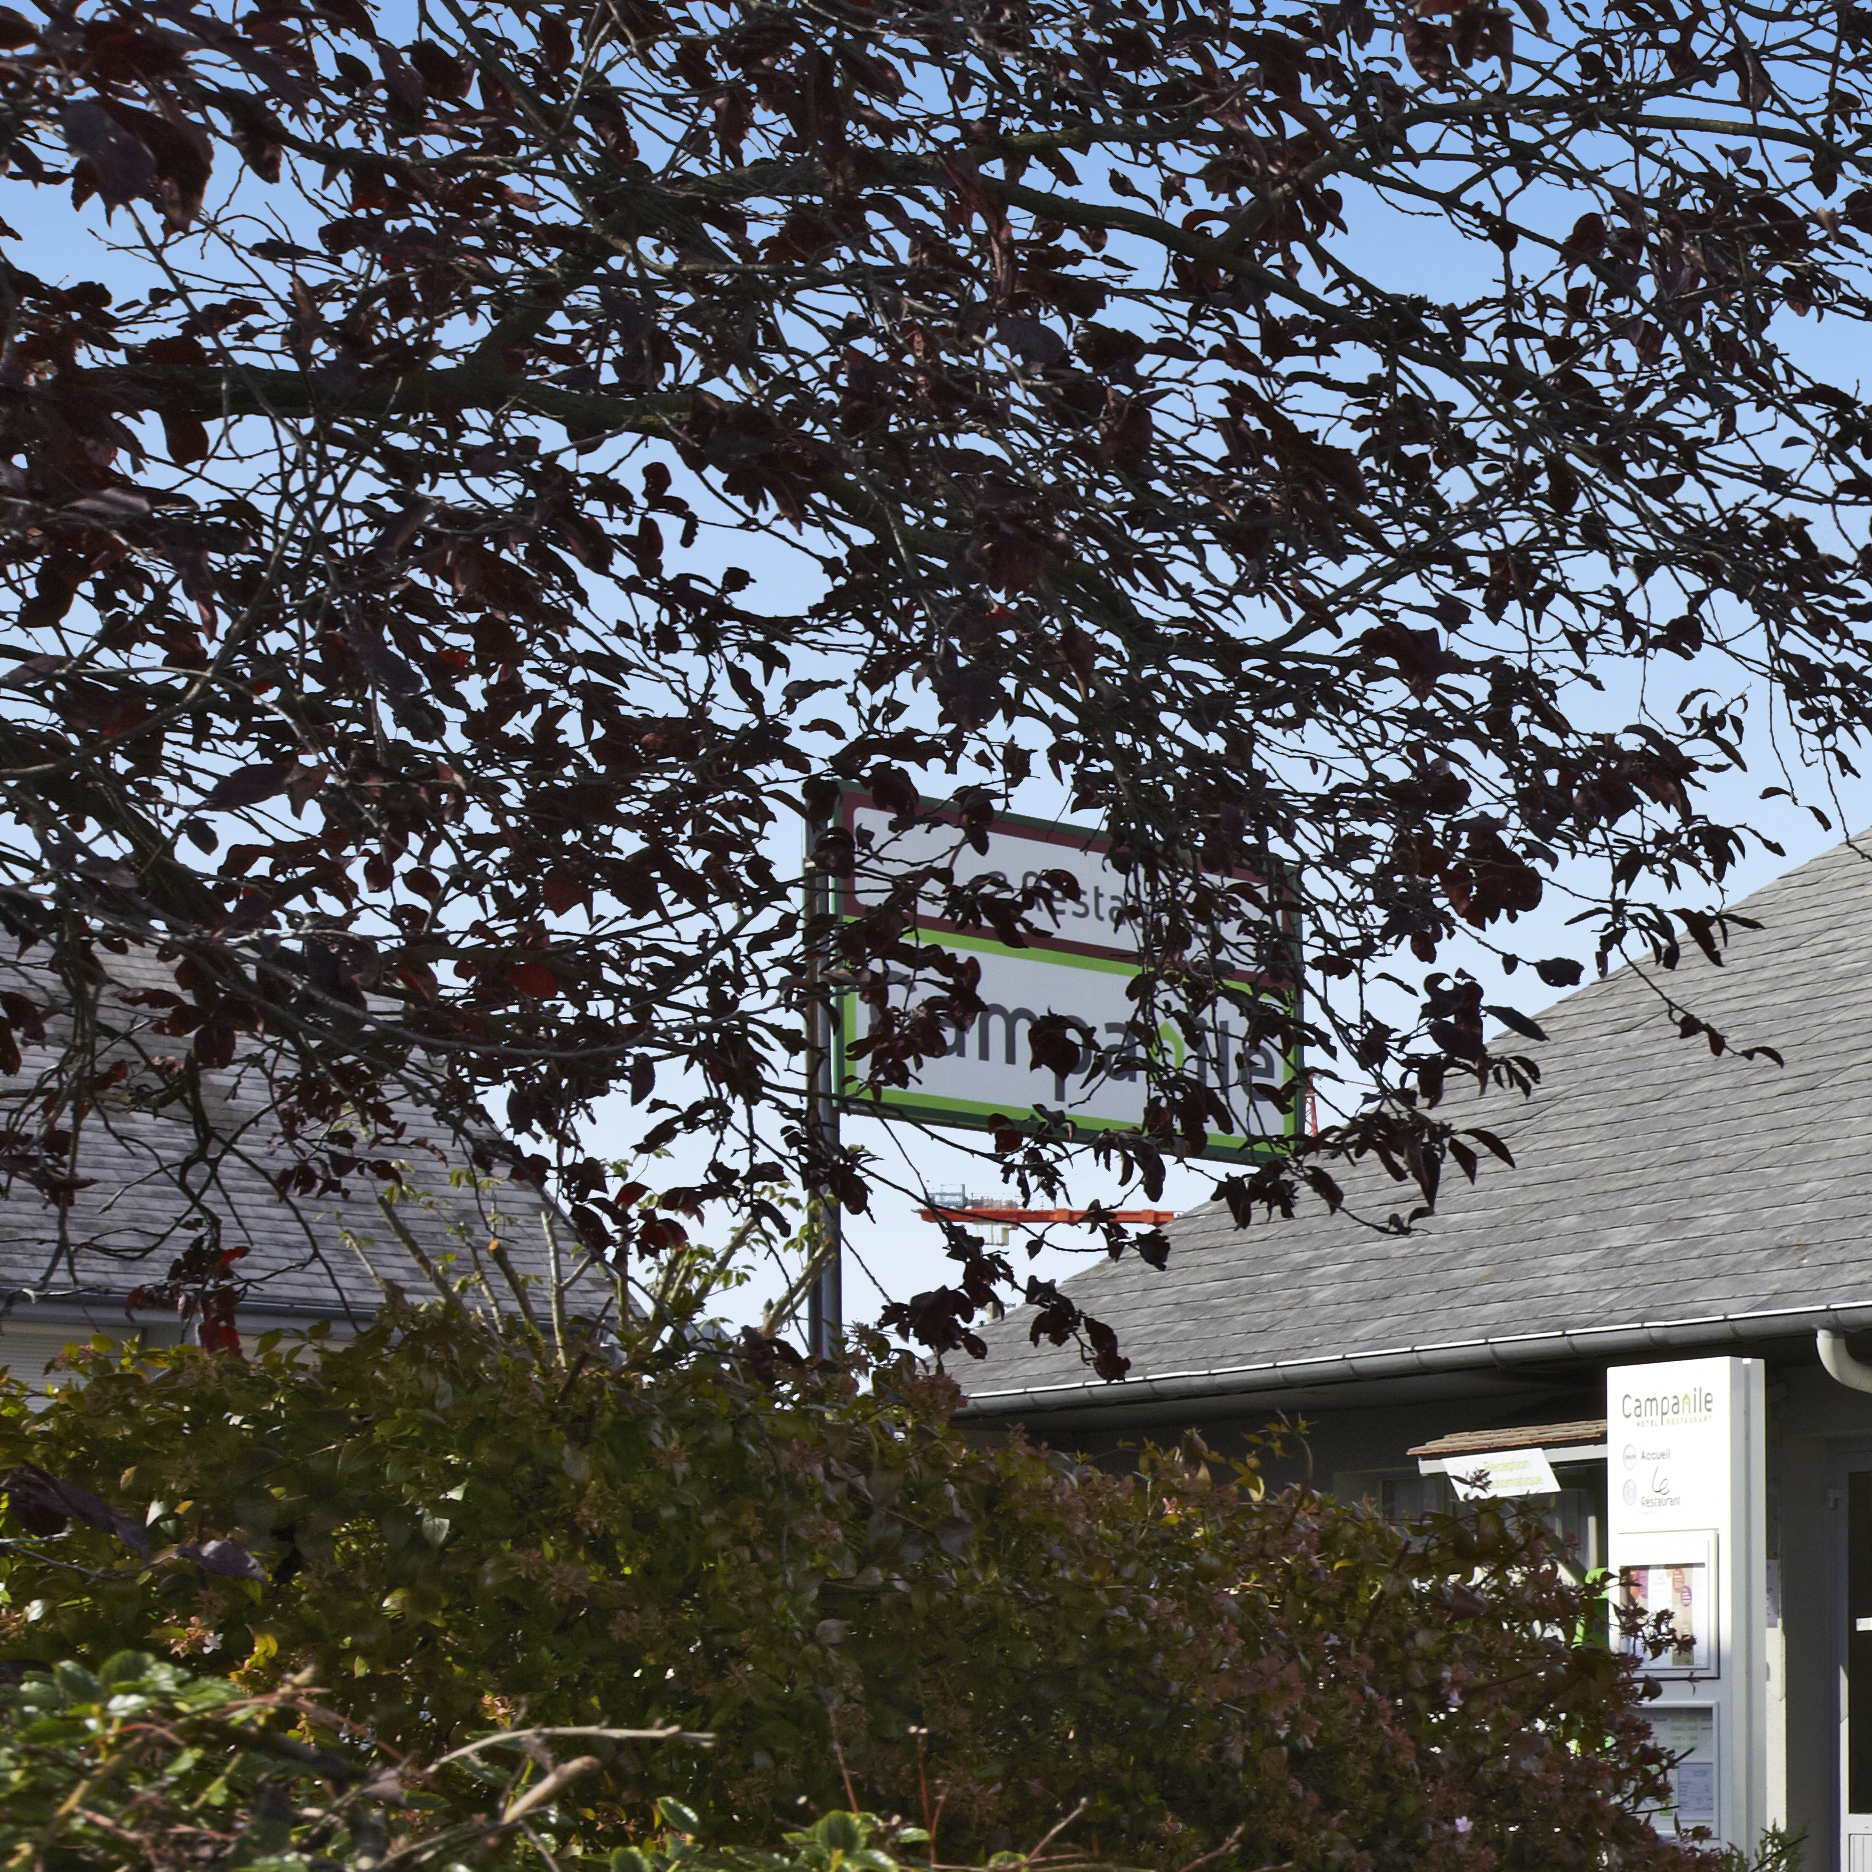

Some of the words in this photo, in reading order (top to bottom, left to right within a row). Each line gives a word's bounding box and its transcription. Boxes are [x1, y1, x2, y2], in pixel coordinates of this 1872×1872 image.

[869, 982, 1276, 1103] ampanile
[1622, 1386, 1713, 1426] Campanile
[1666, 1415, 1713, 1426] RESTAURANT
[1641, 1448, 1671, 1461] Accueil
[1641, 1496, 1681, 1508] Restaurant
